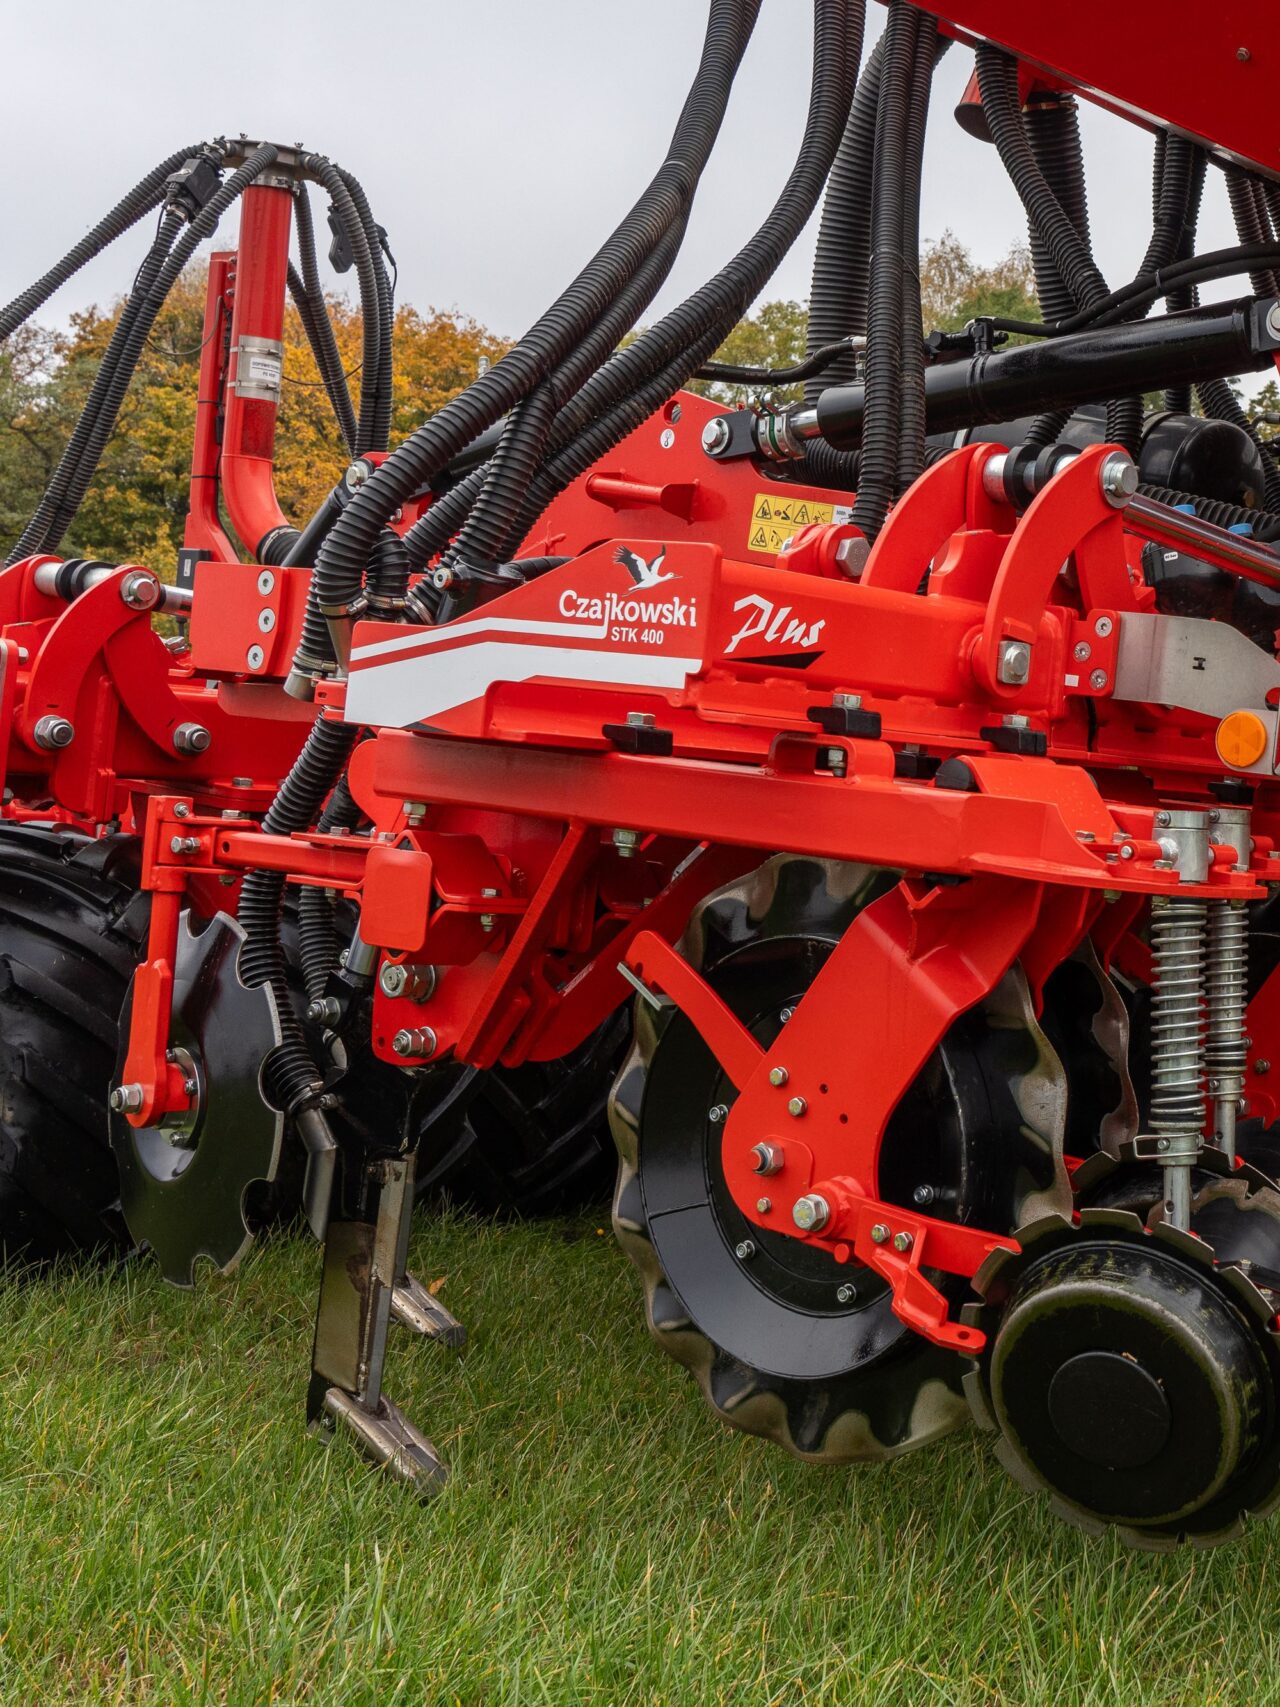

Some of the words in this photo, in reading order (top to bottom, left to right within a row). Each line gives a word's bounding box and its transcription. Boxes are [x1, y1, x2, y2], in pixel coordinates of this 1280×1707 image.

[559, 589, 697, 636] Czajkowski
[610, 626, 638, 643] STK
[640, 629, 664, 645] 400
[723, 593, 826, 654] Plus
